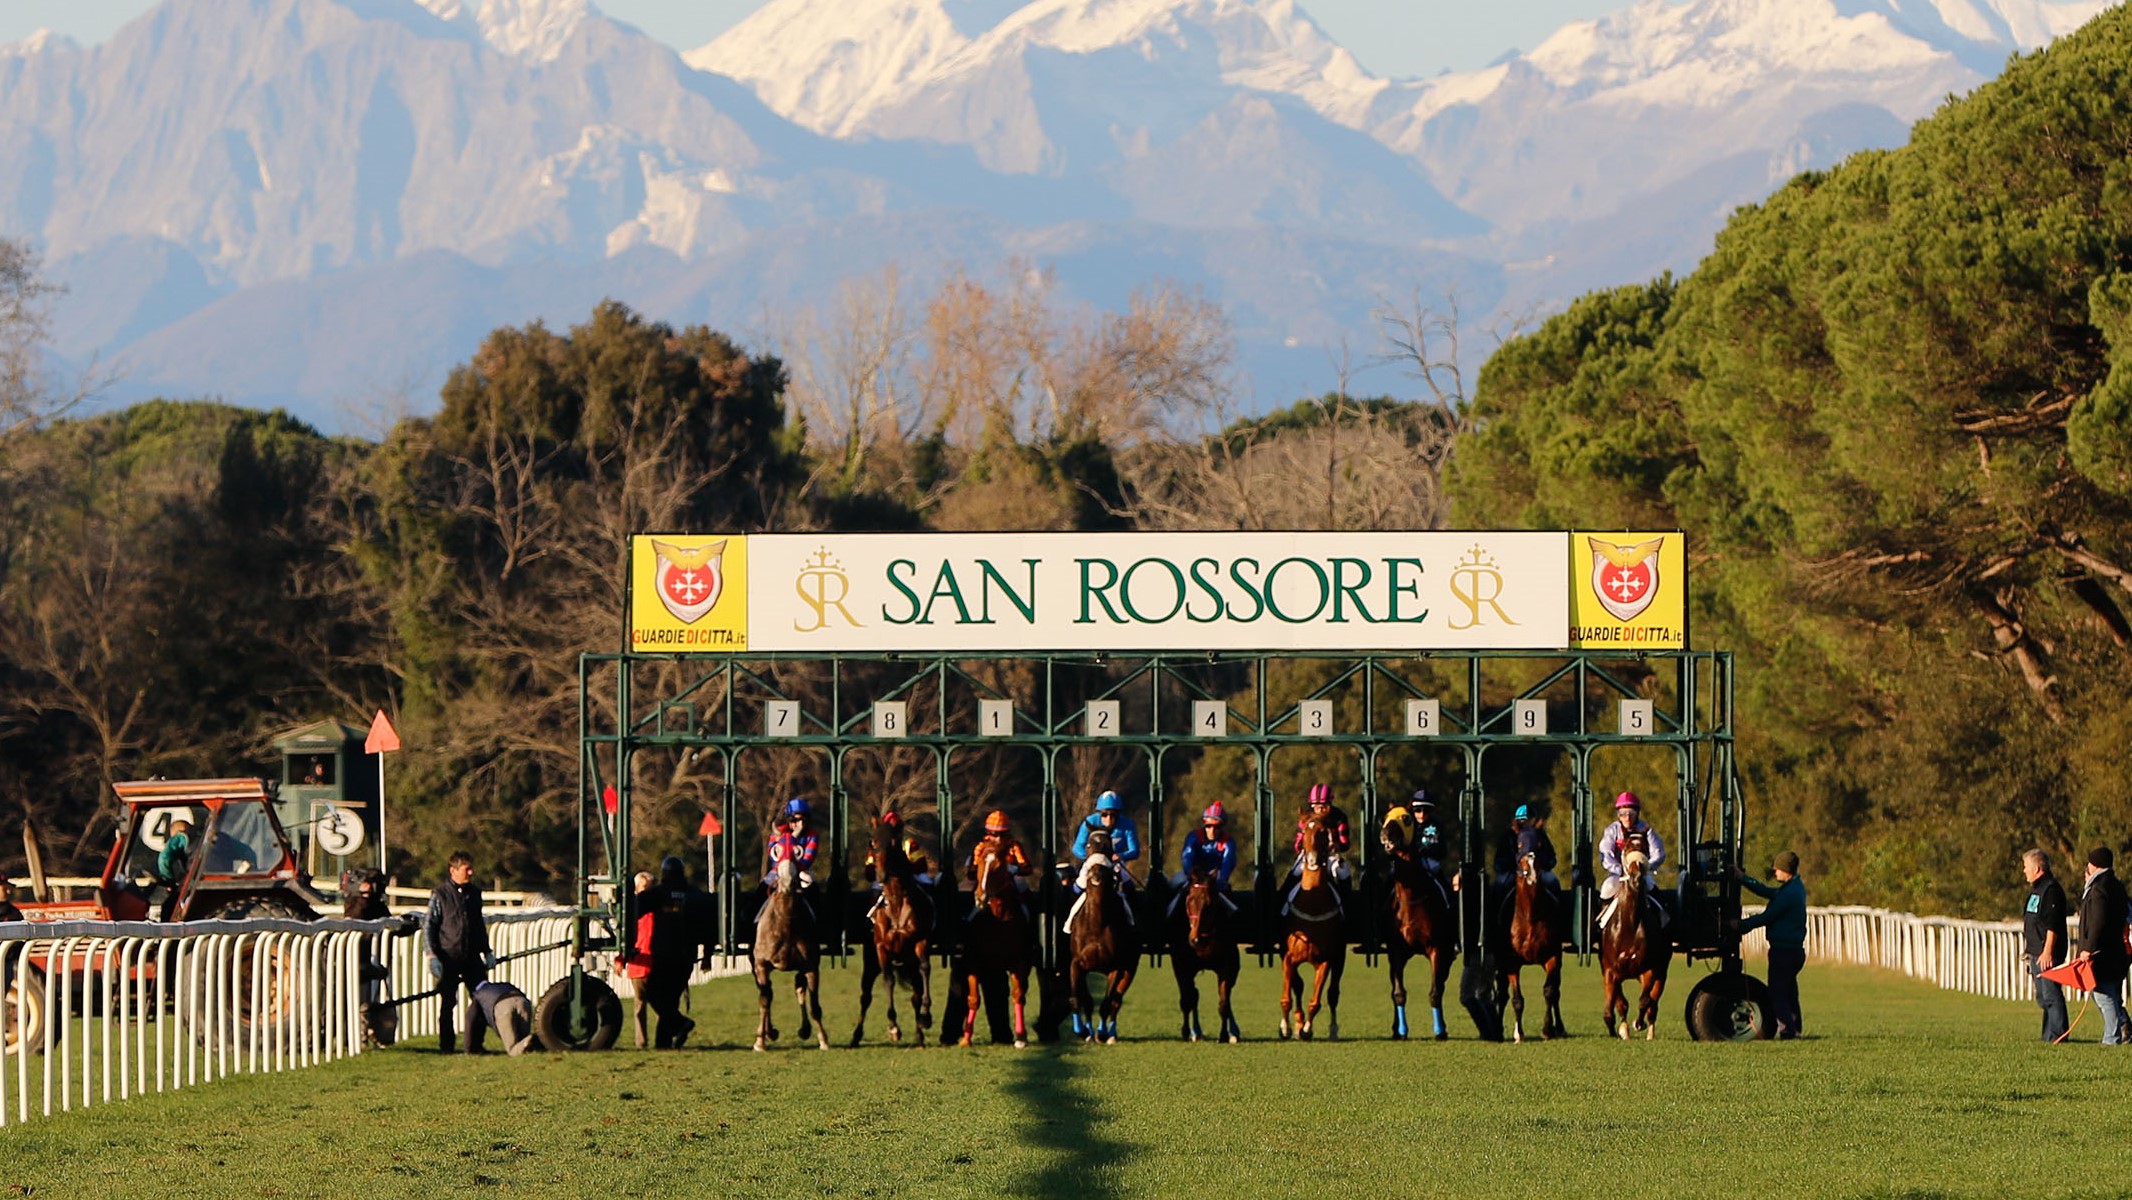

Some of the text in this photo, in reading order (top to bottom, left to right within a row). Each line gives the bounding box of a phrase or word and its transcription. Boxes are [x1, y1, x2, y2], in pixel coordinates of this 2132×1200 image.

[882, 557, 1429, 625] SAN ROSSORE
[777, 709, 788, 727] 7
[884, 712, 896, 730] 8
[1098, 710, 1109, 729] 2
[1205, 711, 1217, 729] 4
[1311, 710, 1323, 728] 3
[1417, 710, 1429, 729] 6
[1524, 710, 1535, 728] 9
[1631, 710, 1642, 728] 5
[152, 812, 172, 844] 4
